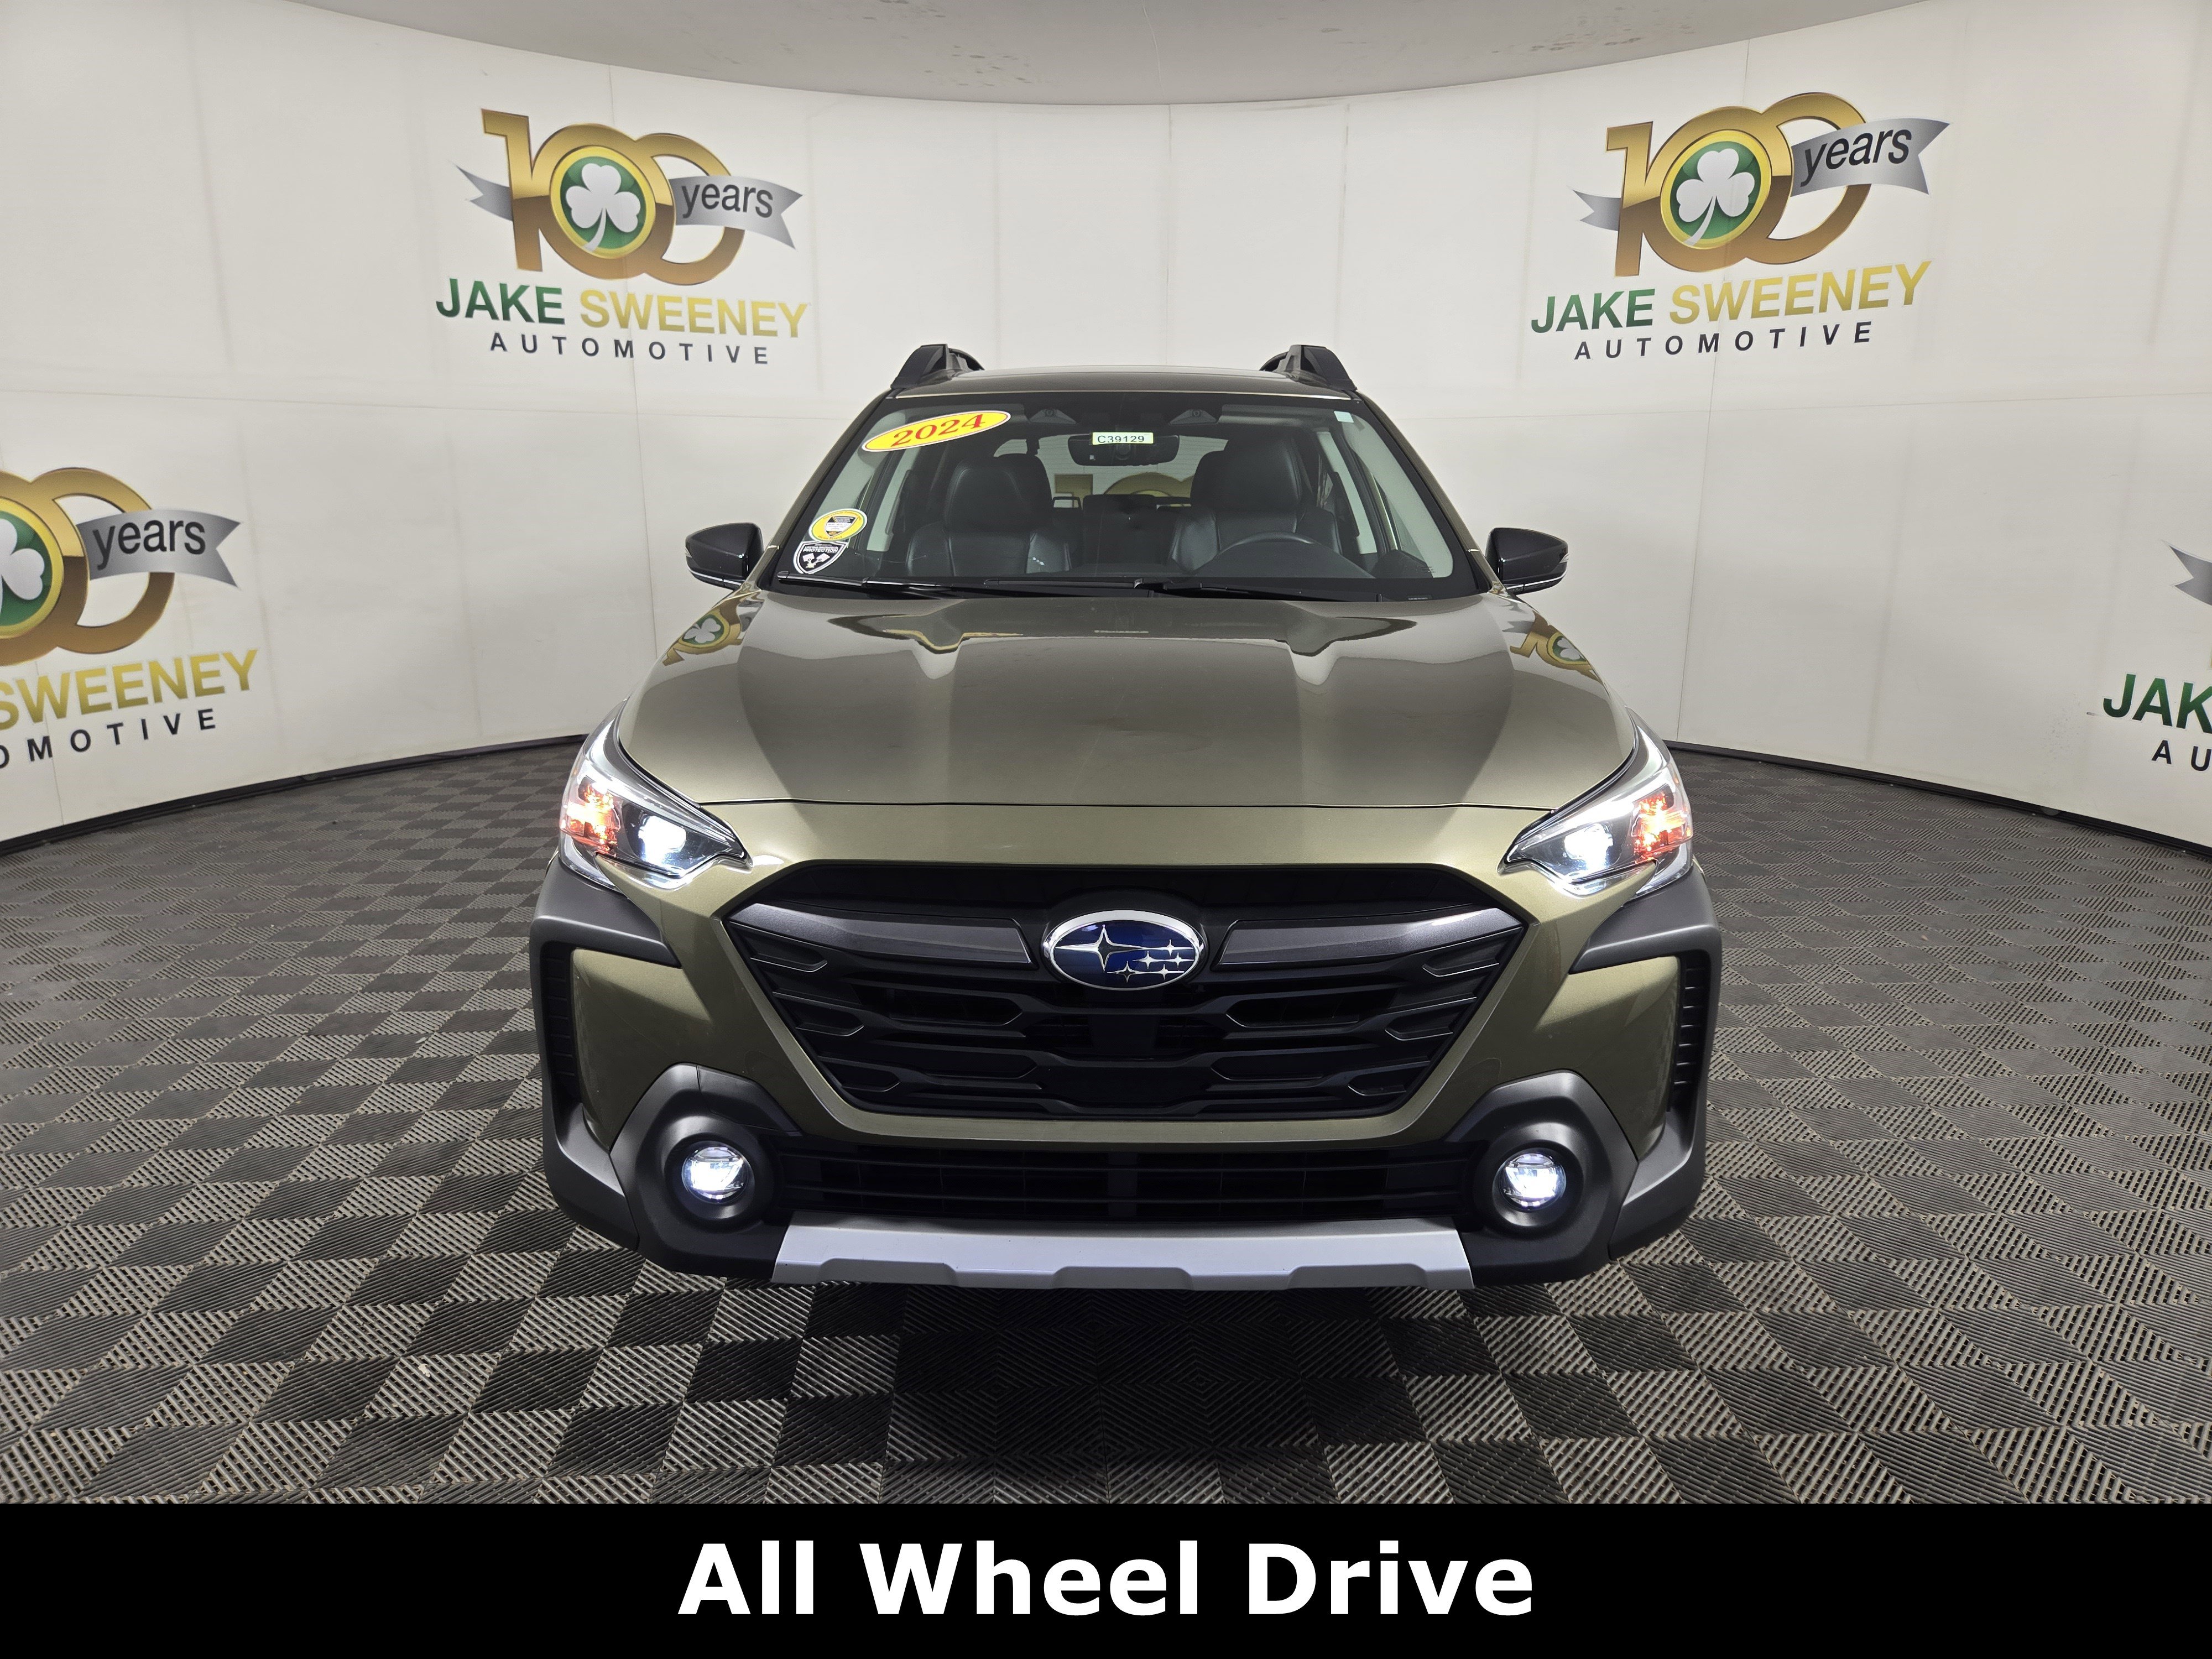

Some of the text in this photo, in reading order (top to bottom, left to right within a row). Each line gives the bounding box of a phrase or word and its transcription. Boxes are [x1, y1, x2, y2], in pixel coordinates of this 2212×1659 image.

[481, 108, 773, 285] 100 years
[1606, 92, 1912, 277] 100 years
[436, 278, 807, 337] JAKE SWEENEY
[1531, 260, 1932, 333] JAKE SWEENEY
[490, 332, 768, 364] AUTOMOTIVE
[1575, 321, 1873, 360] AUTOMOTIVE
[890, 414, 985, 447] 2024
[92, 519, 206, 570] years
